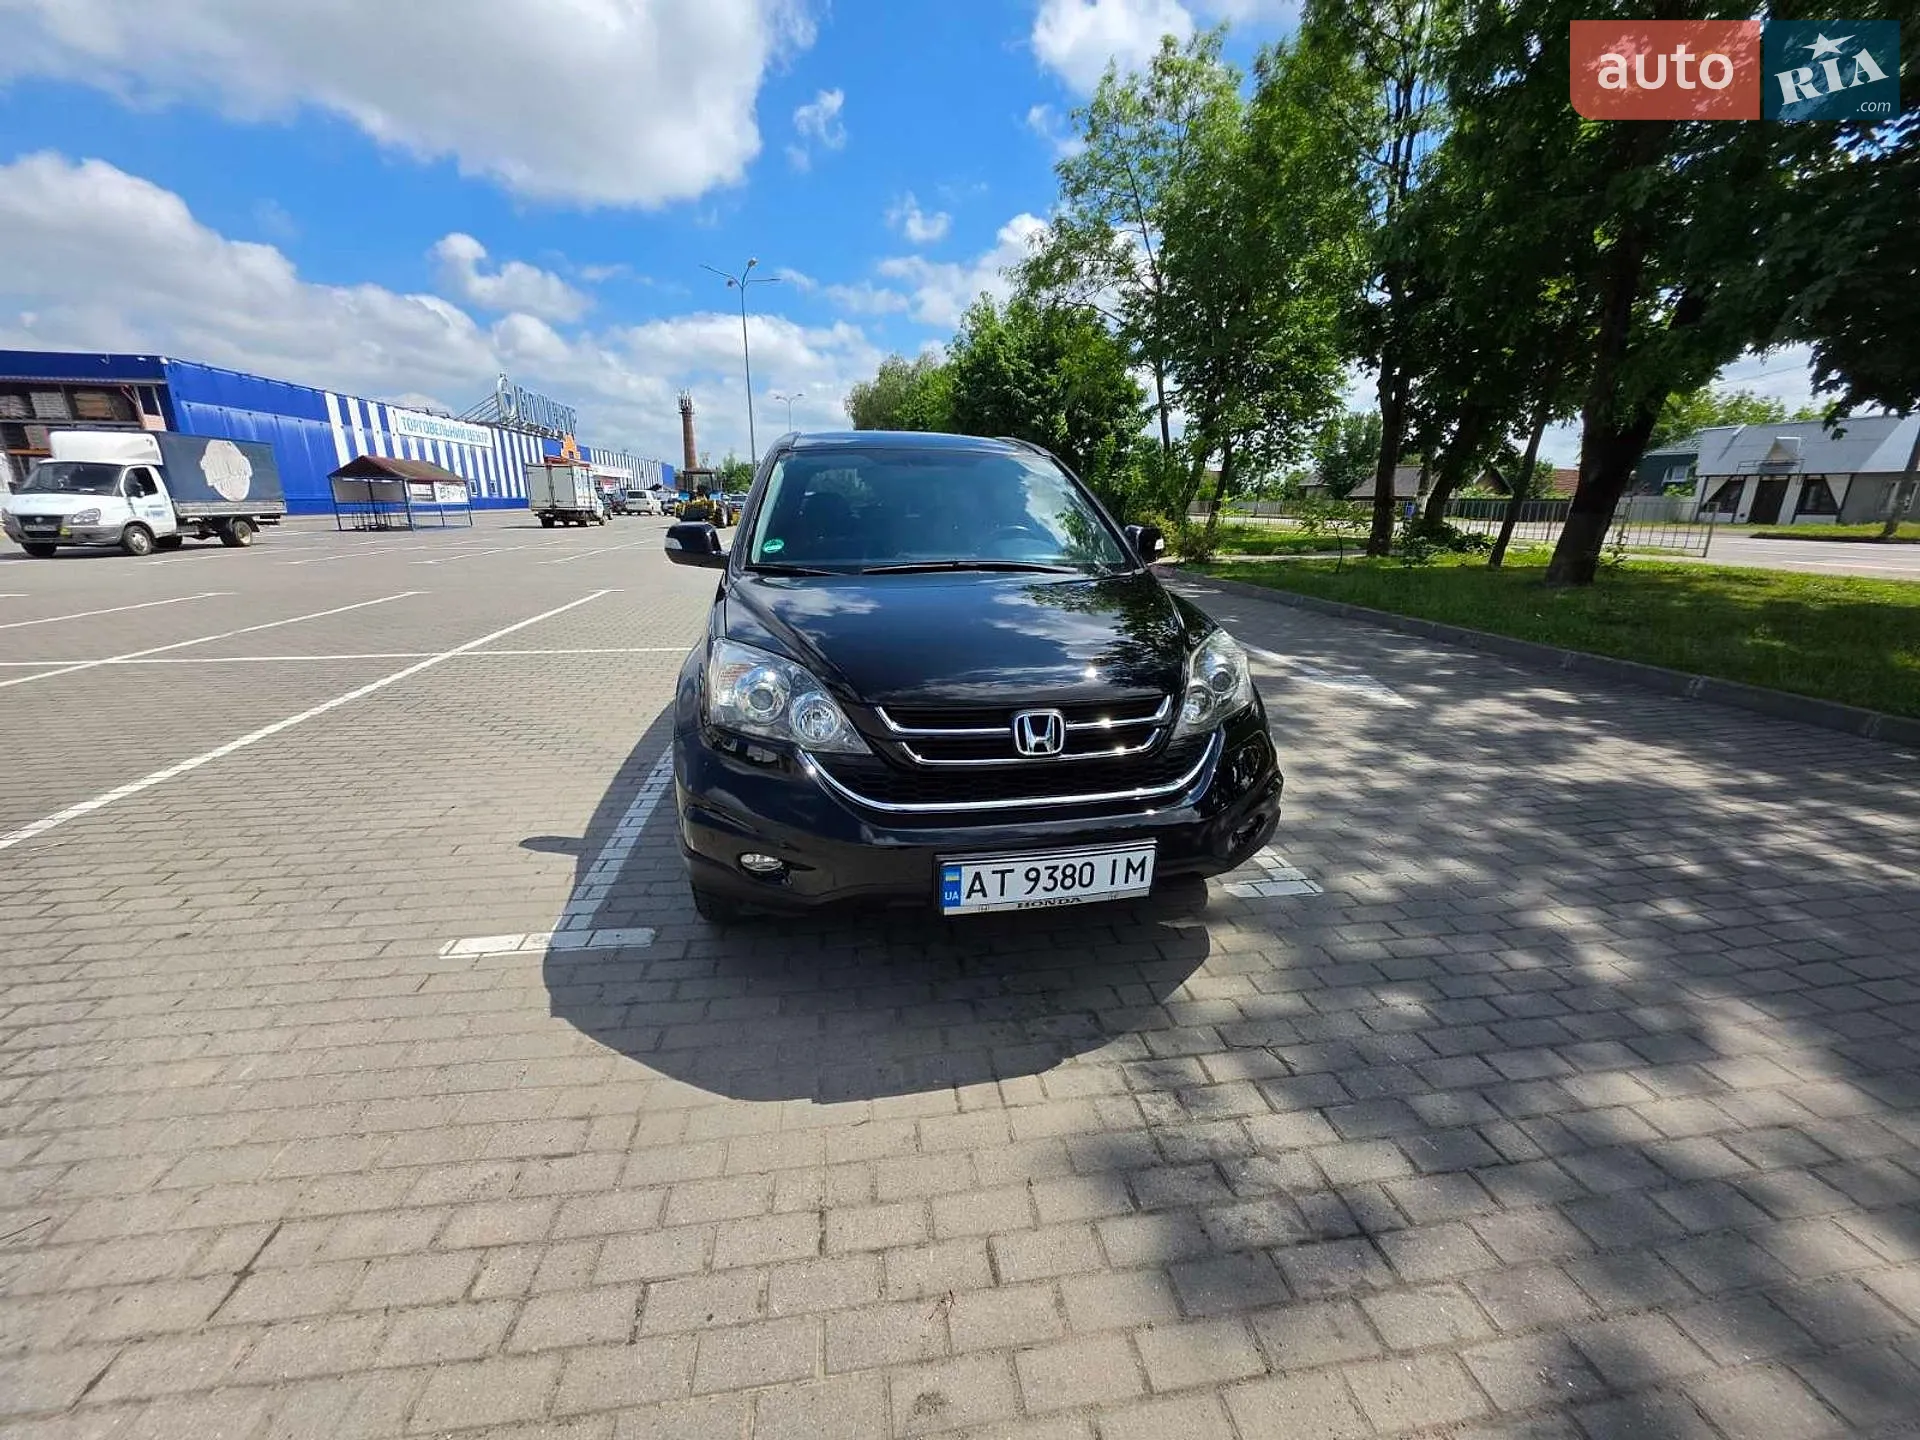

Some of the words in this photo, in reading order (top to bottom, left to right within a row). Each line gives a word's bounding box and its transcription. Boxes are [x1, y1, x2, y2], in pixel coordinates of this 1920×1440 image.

[966, 869, 1014, 899] AT
[1024, 862, 1095, 895] 9380
[1110, 856, 1147, 885] IM
[944, 891, 959, 901] UA
[1017, 898, 1082, 908] HONDA
